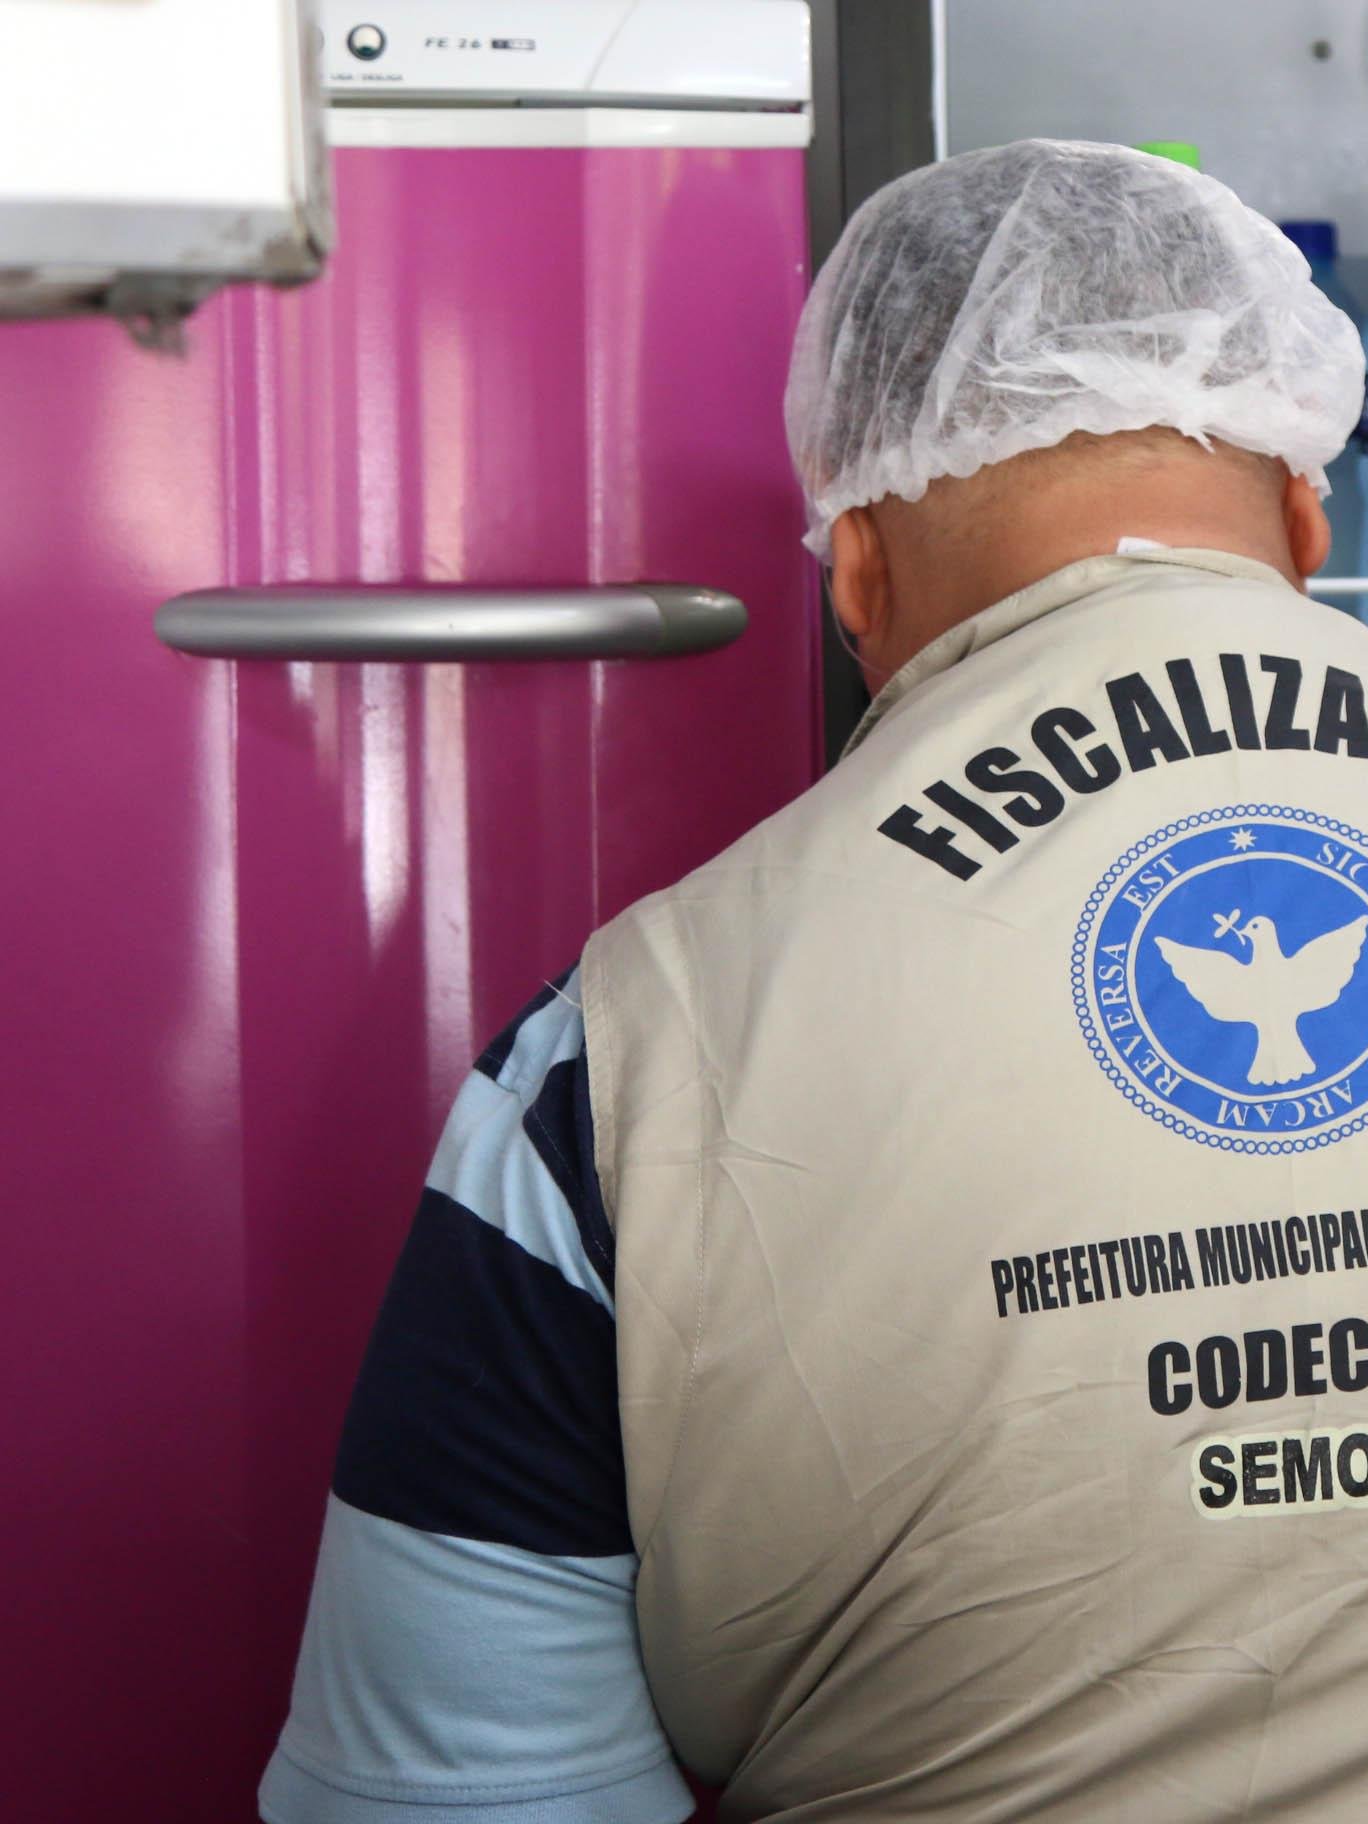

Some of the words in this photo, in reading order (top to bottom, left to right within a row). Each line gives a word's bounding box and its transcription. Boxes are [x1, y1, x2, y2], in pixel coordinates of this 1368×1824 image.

[1121, 853, 1181, 913] EST
[1098, 942, 1183, 1098] REVERSA
[1215, 1079, 1353, 1127] ARCAM
[991, 1232, 1195, 1318] PREFEITURA
